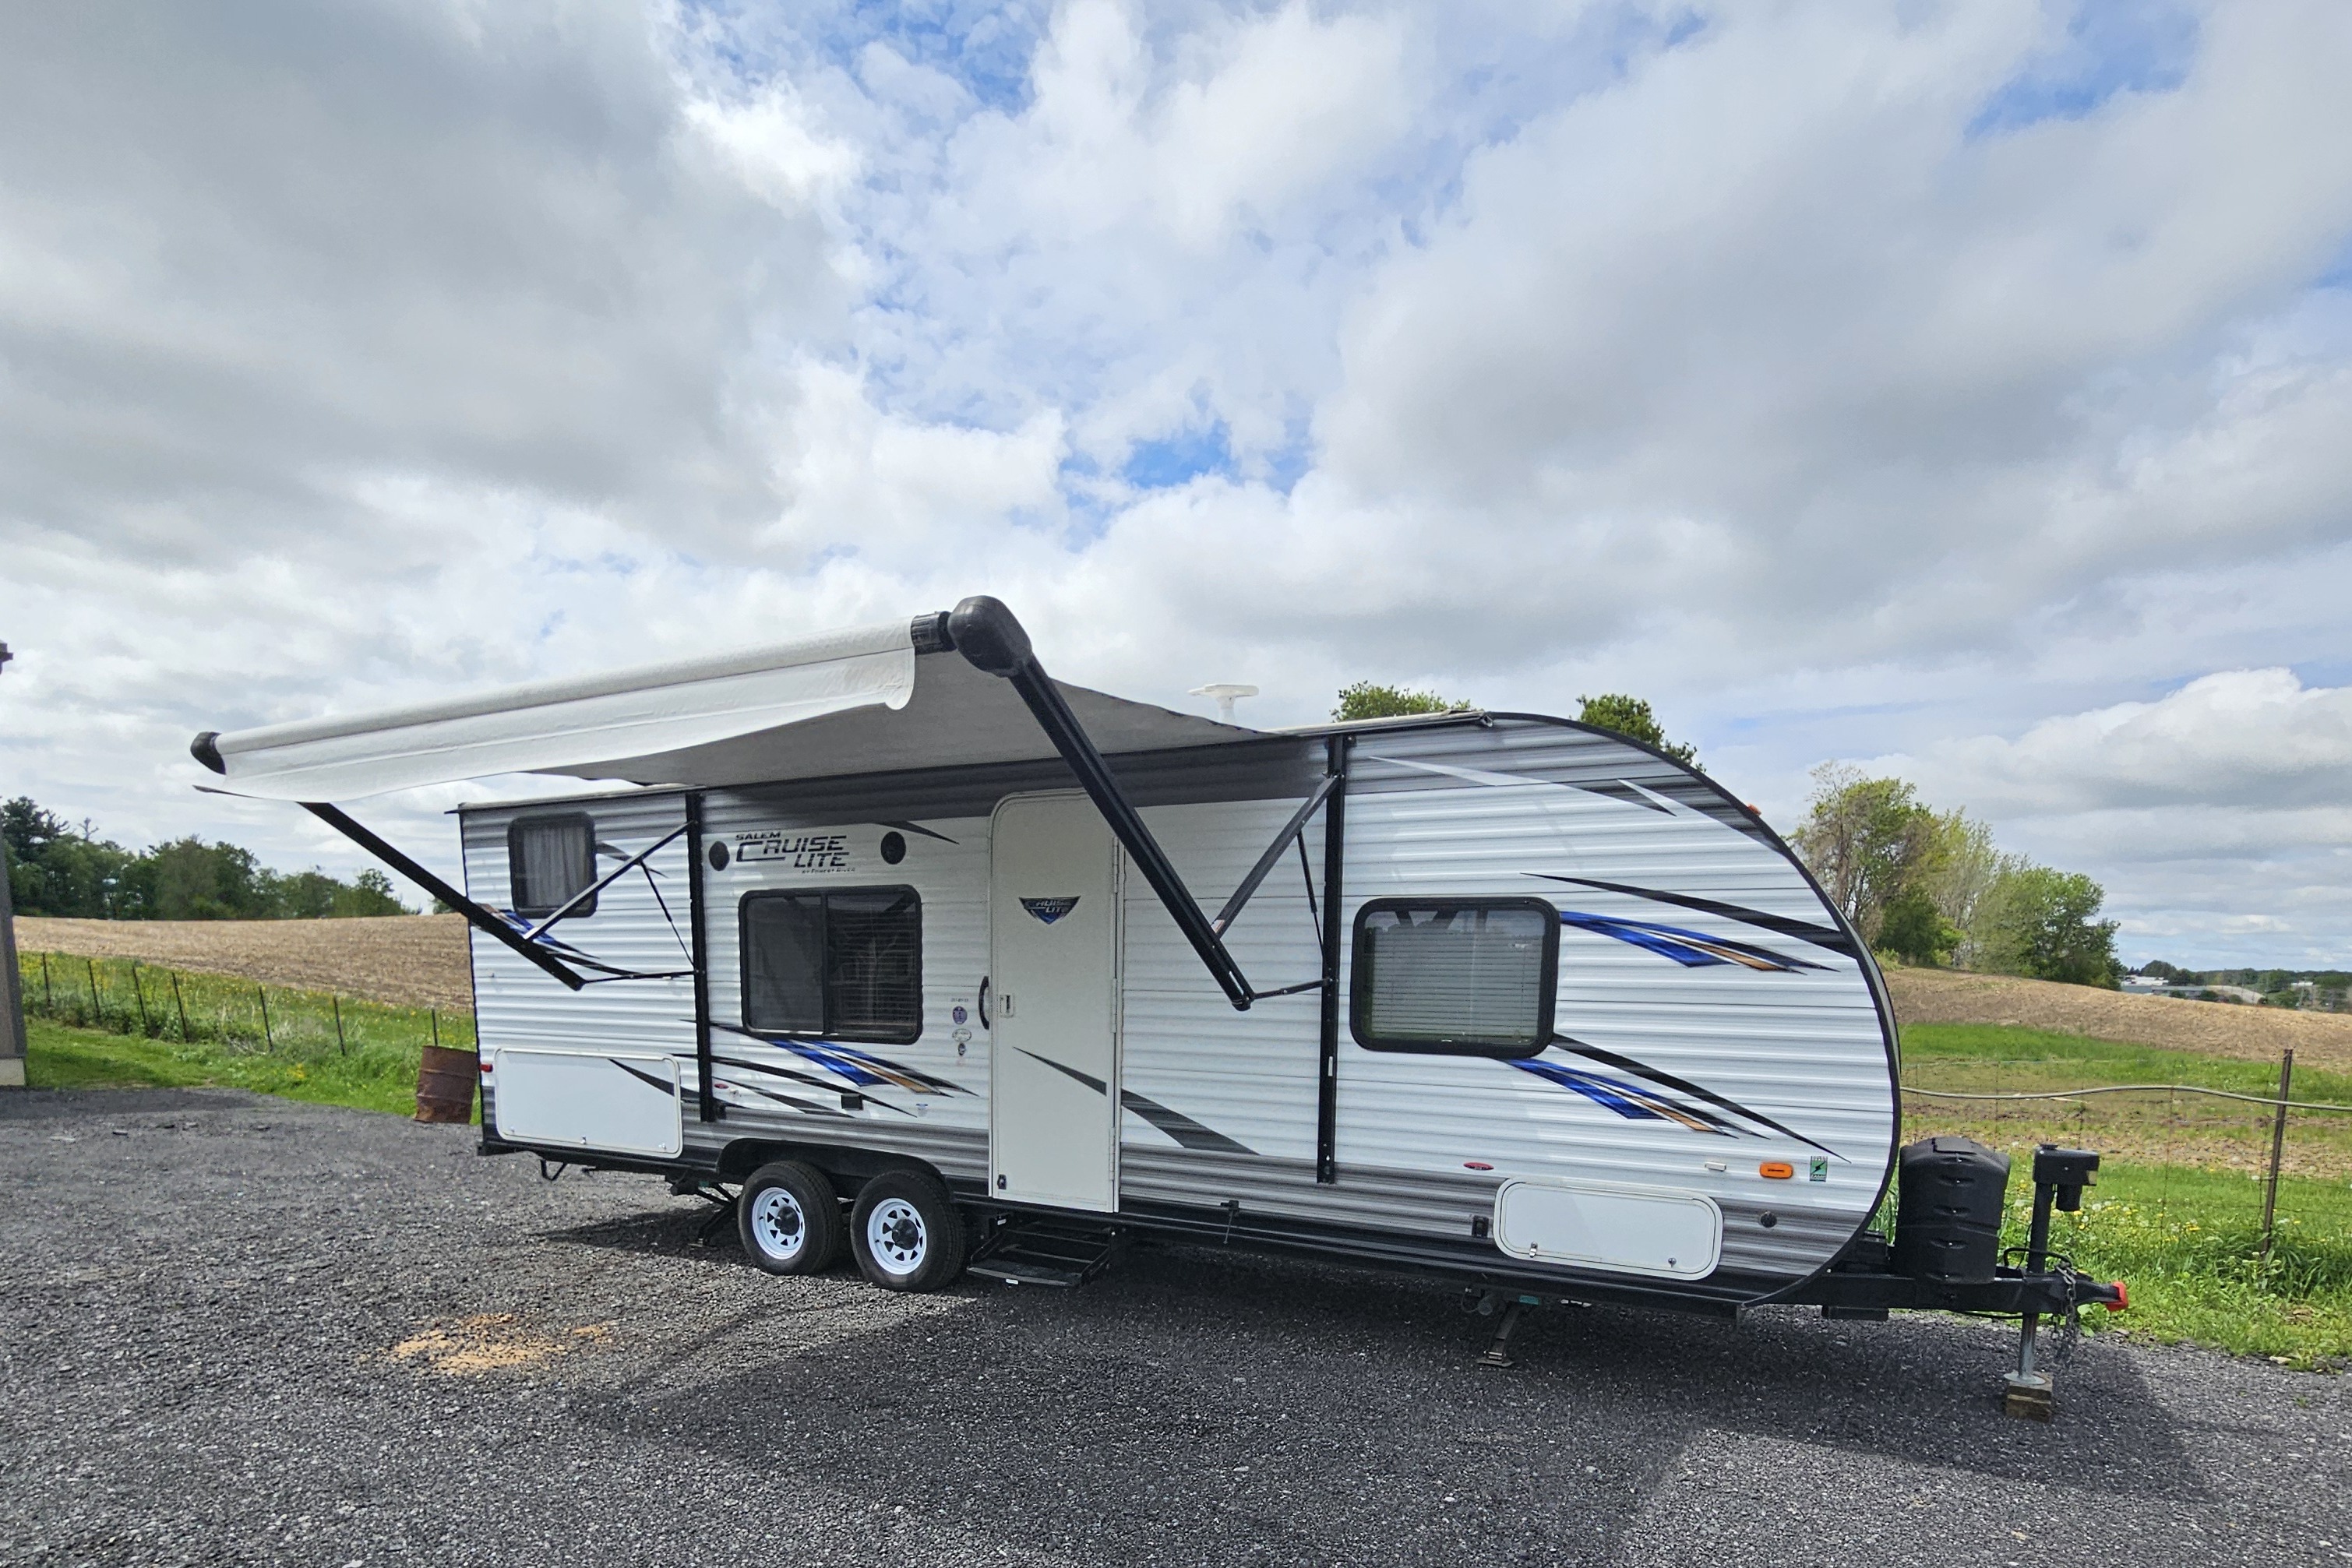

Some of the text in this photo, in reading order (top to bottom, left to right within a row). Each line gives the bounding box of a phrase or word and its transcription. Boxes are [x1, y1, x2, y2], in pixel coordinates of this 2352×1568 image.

[735, 831, 781, 841] SALEM
[736, 835, 847, 862] CRUISE
[794, 852, 850, 868] LITE
